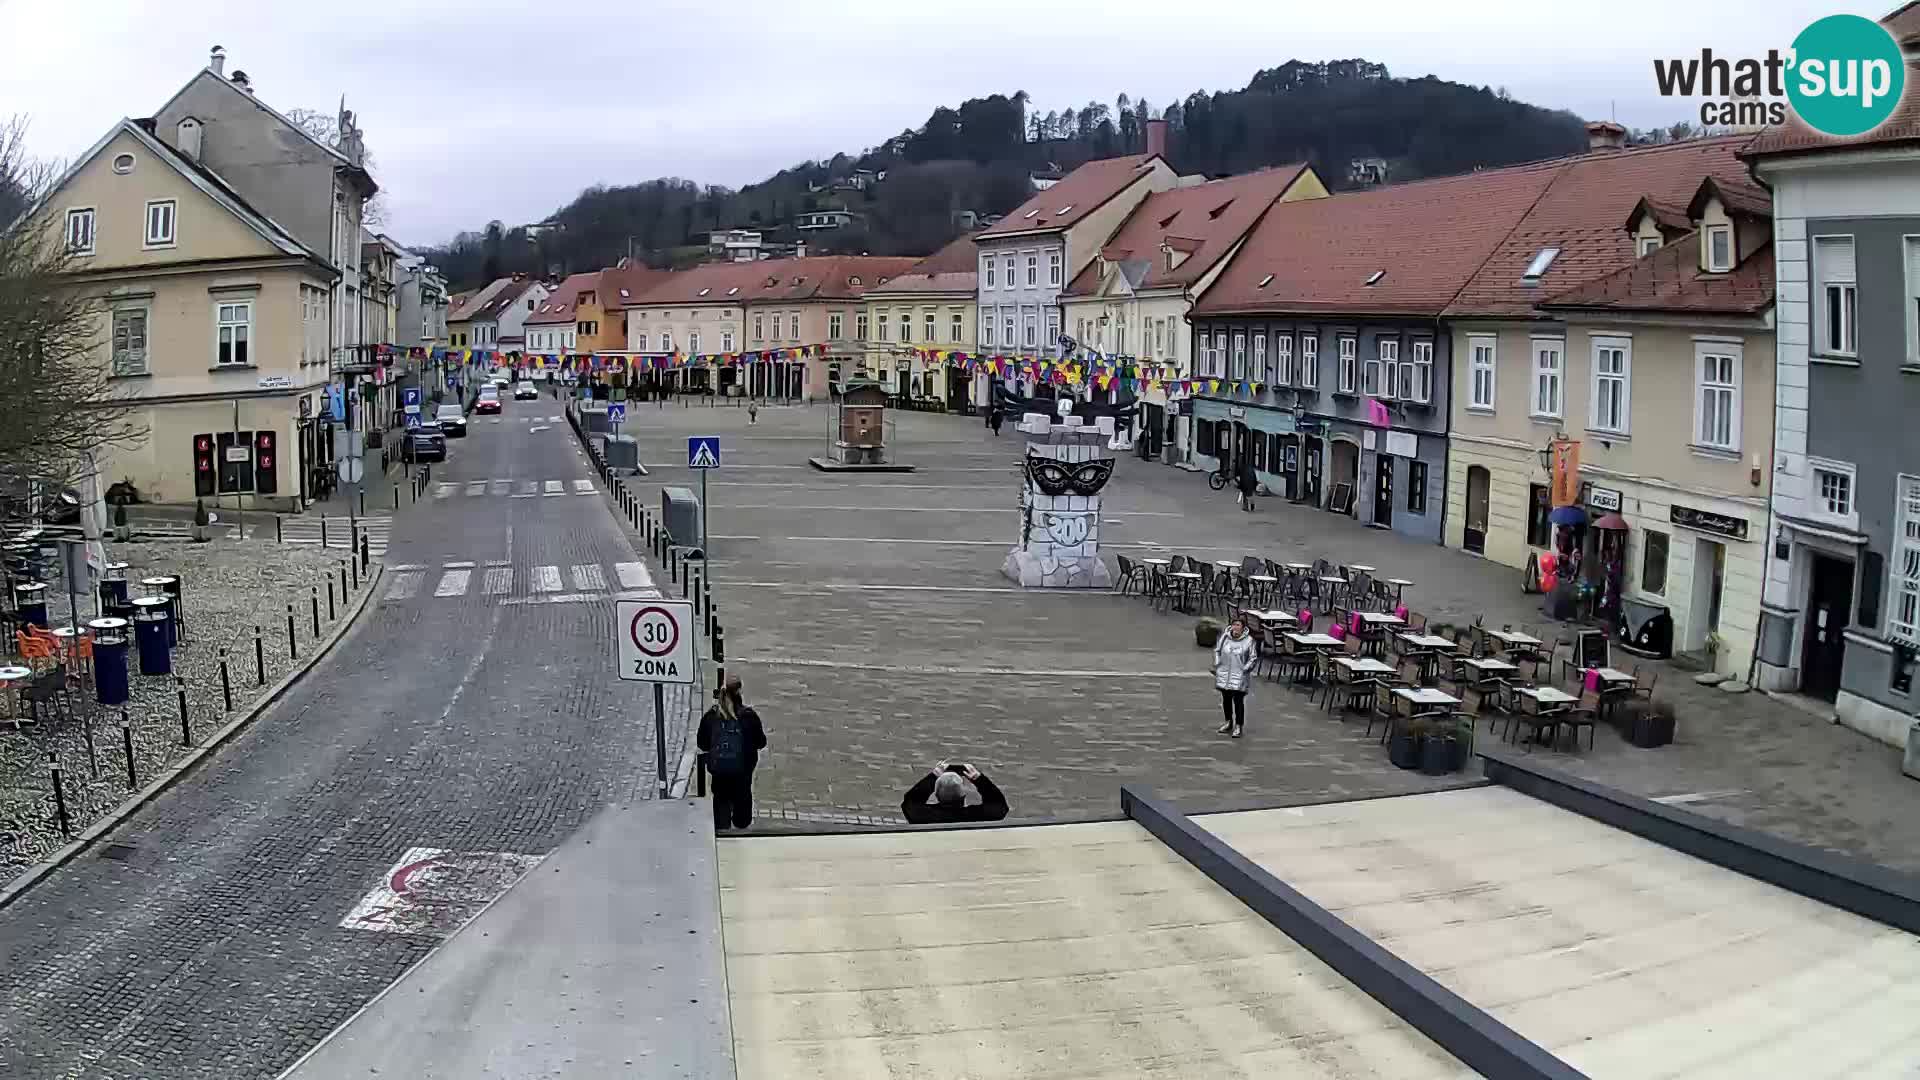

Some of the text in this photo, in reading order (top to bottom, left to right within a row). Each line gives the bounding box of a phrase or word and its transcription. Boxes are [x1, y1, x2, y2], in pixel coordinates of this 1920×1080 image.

[408, 391, 416, 402] P
[1048, 516, 1088, 545] 200
[644, 622, 667, 643] 30
[634, 660, 678, 676] ZONA
